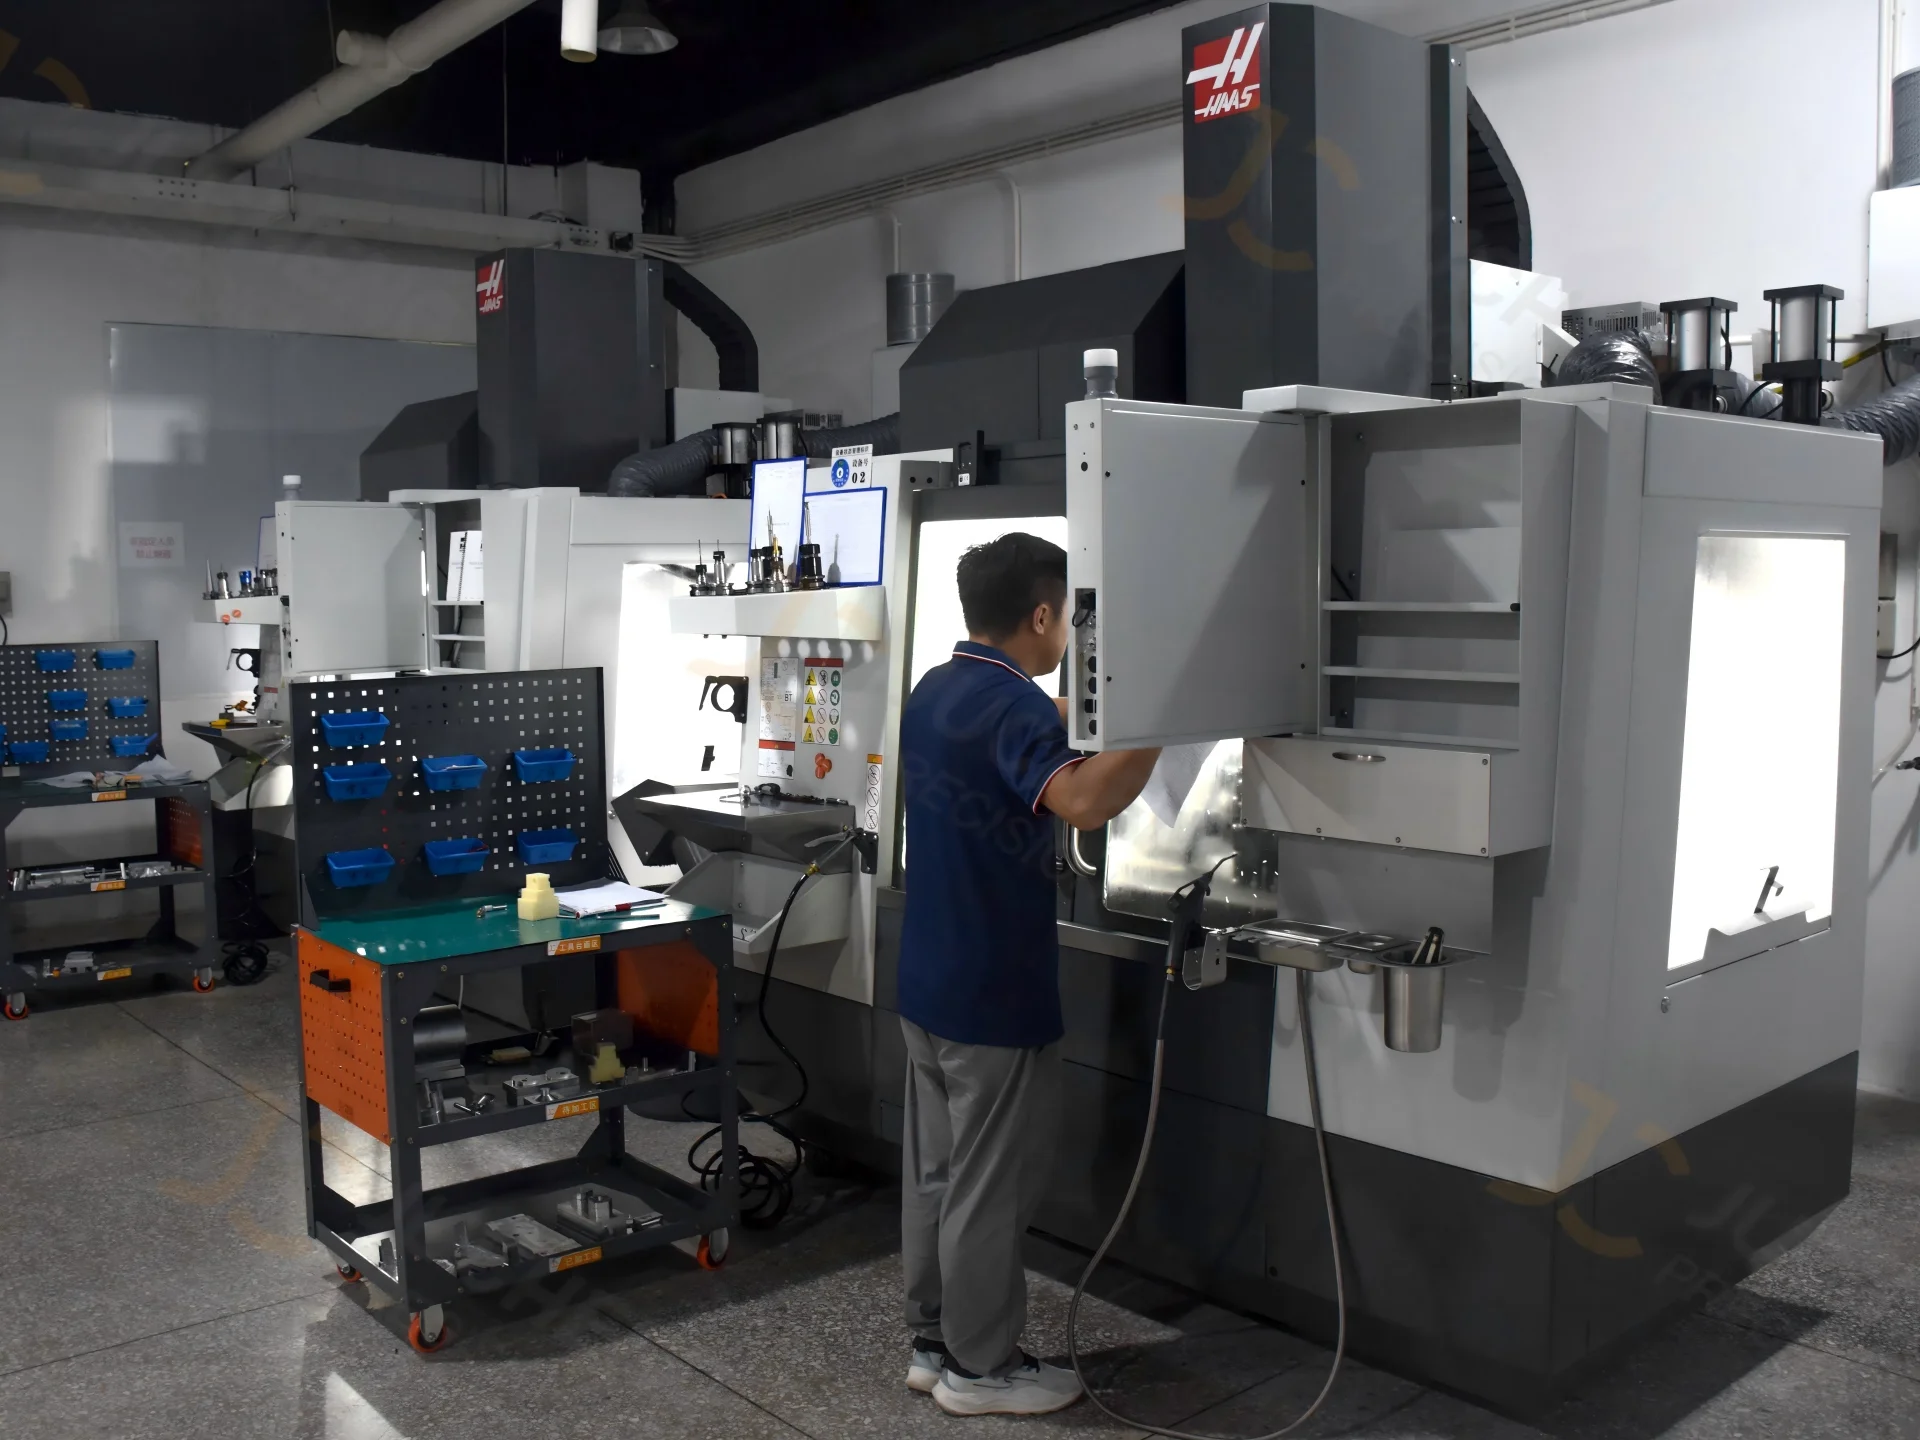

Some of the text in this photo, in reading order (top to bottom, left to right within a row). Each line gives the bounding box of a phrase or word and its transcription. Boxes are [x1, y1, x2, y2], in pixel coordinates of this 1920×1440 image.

[1195, 84, 1260, 117] HAAS
[479, 295, 503, 313] HAAS
[852, 458, 869, 468] 设备号
[784, 693, 793, 702] BT
